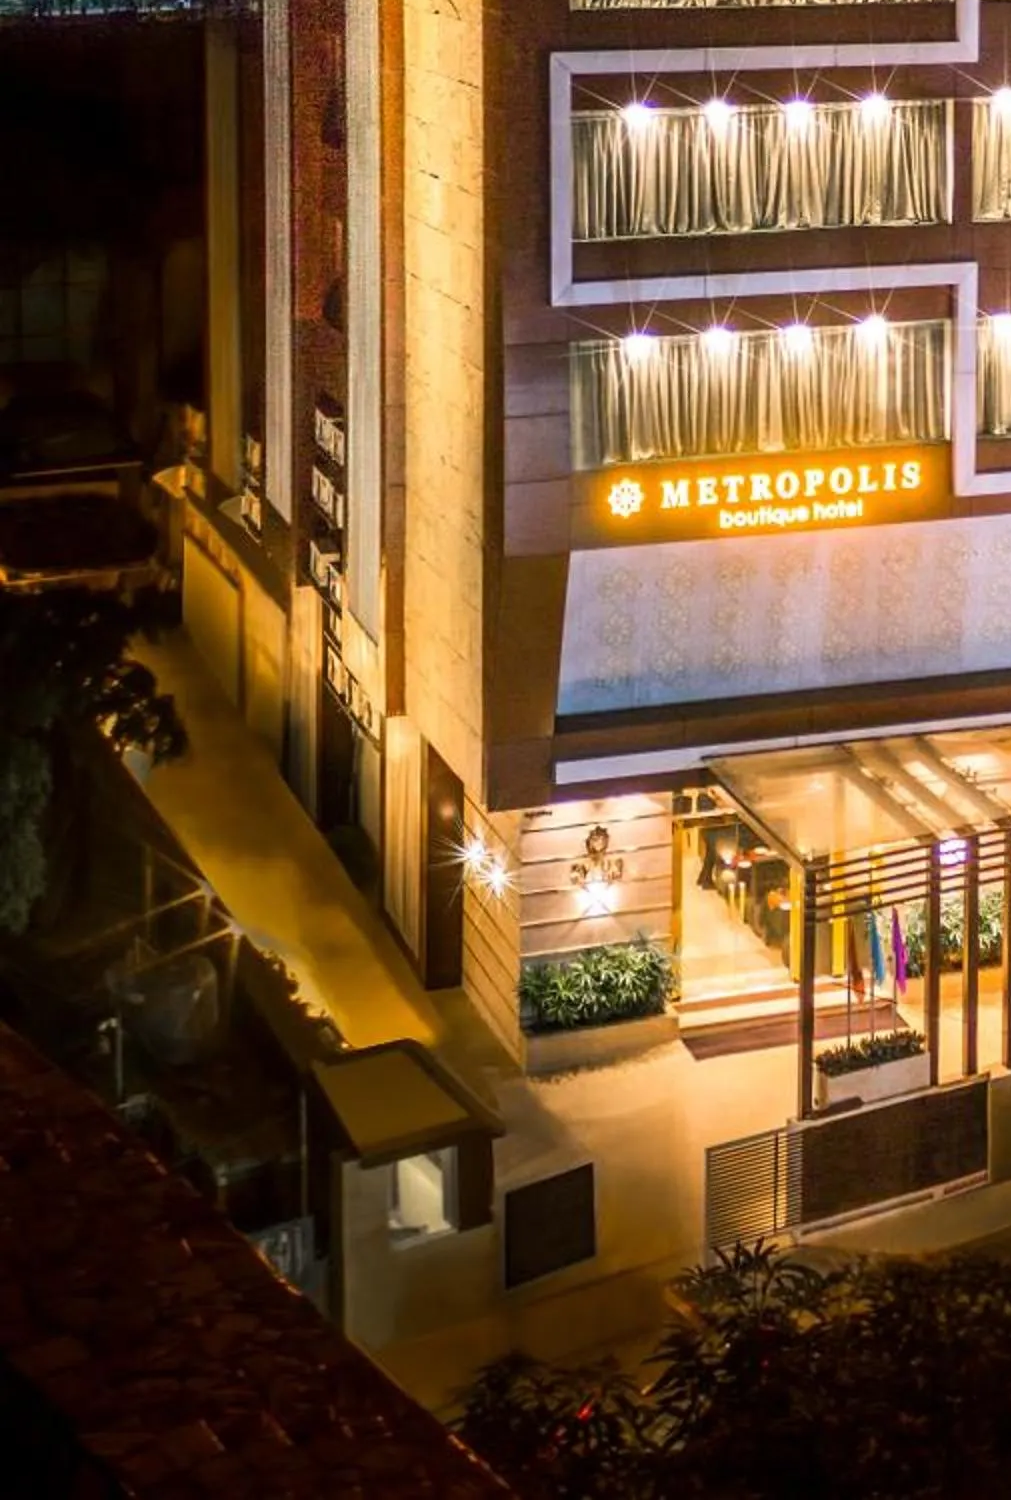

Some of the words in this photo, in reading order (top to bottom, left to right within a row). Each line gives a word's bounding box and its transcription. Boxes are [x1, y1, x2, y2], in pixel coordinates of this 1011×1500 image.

[661, 462, 921, 509] METROPOLIS
[719, 506, 810, 529] boutique
[813, 500, 863, 520] hotel
